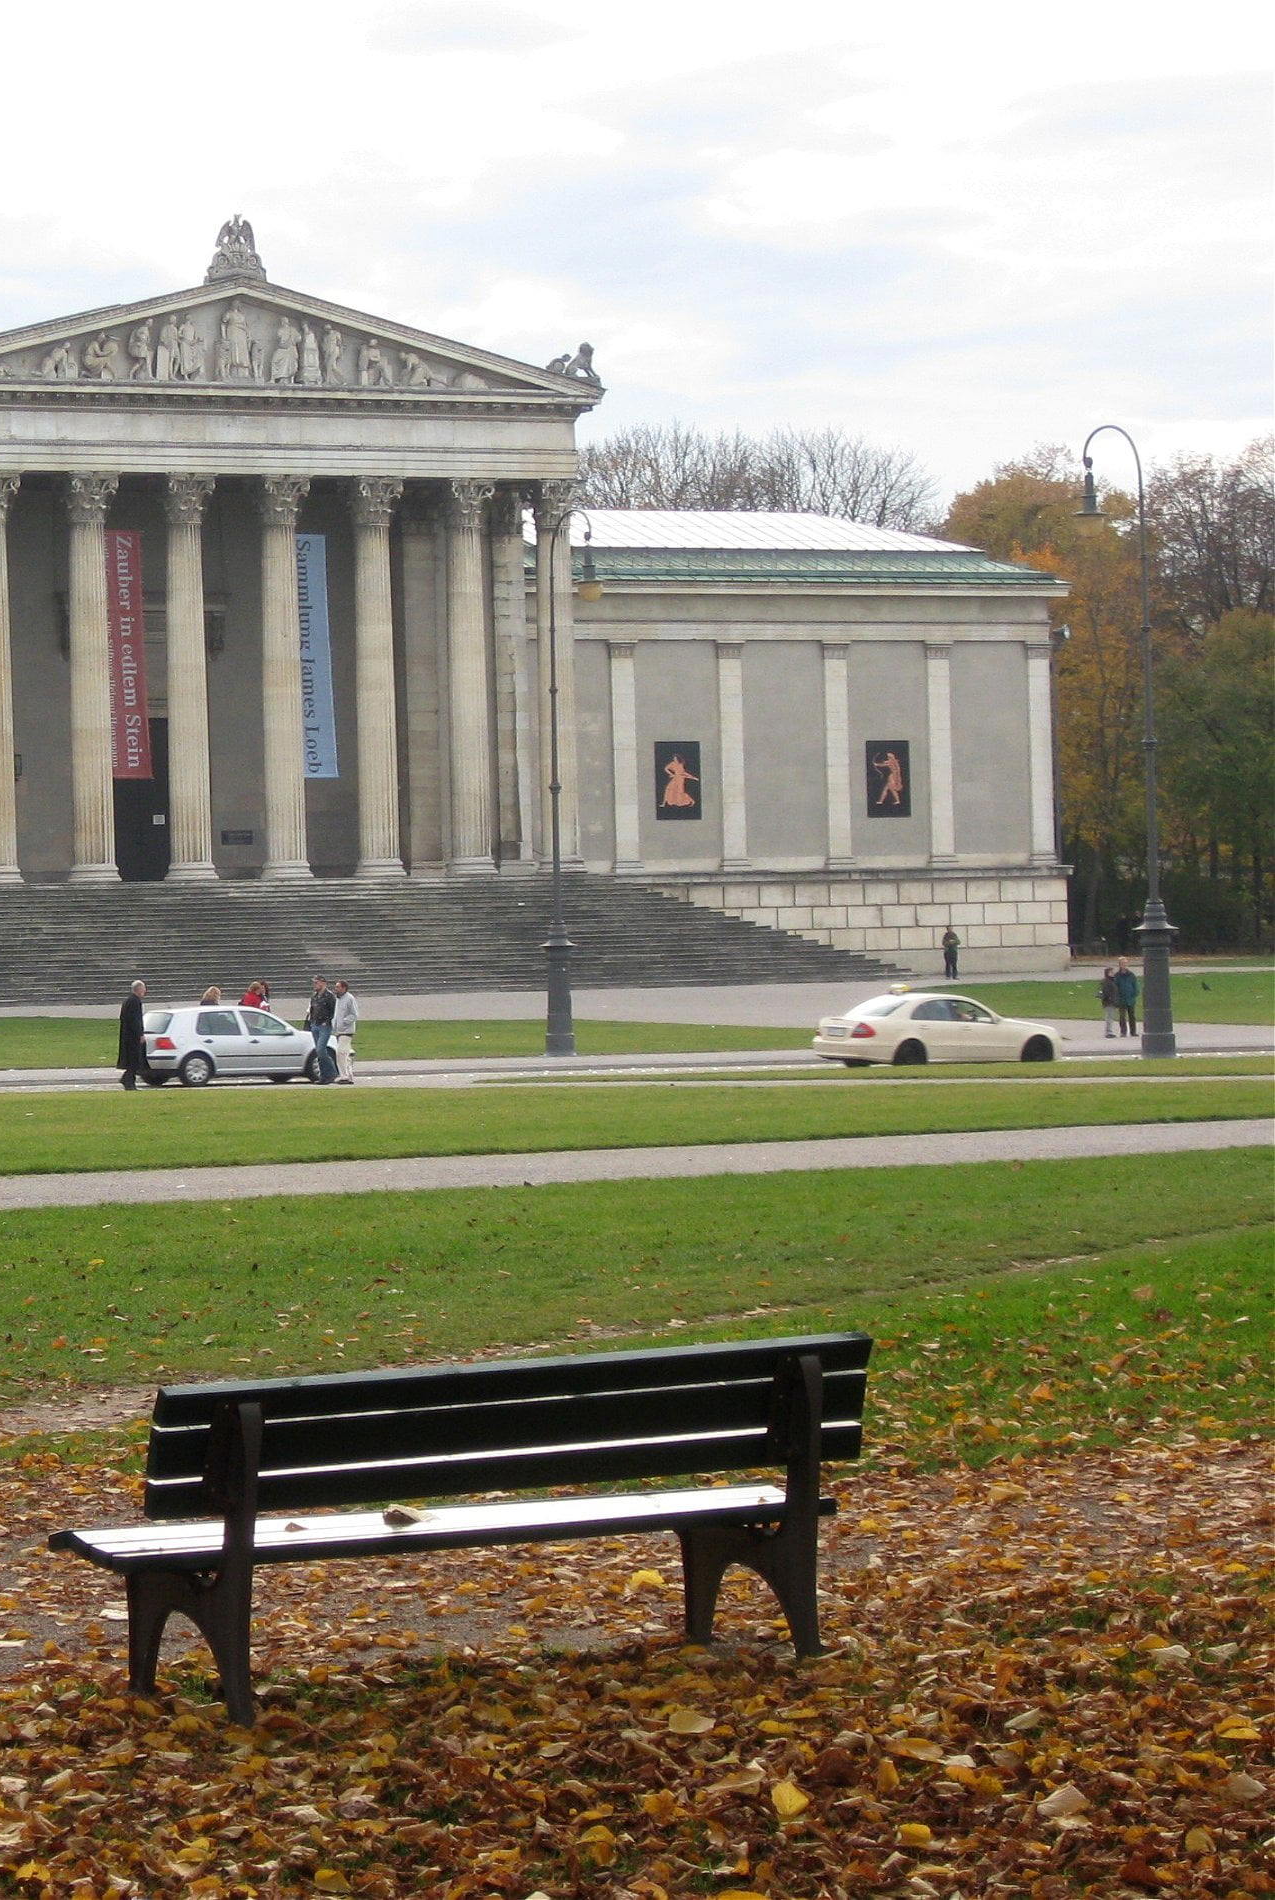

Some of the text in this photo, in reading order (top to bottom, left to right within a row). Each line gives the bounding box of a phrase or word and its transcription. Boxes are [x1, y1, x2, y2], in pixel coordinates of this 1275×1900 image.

[116, 536, 143, 768] Zauber in edlem Stein
[296, 539, 323, 773] Sammlung James Loeb
